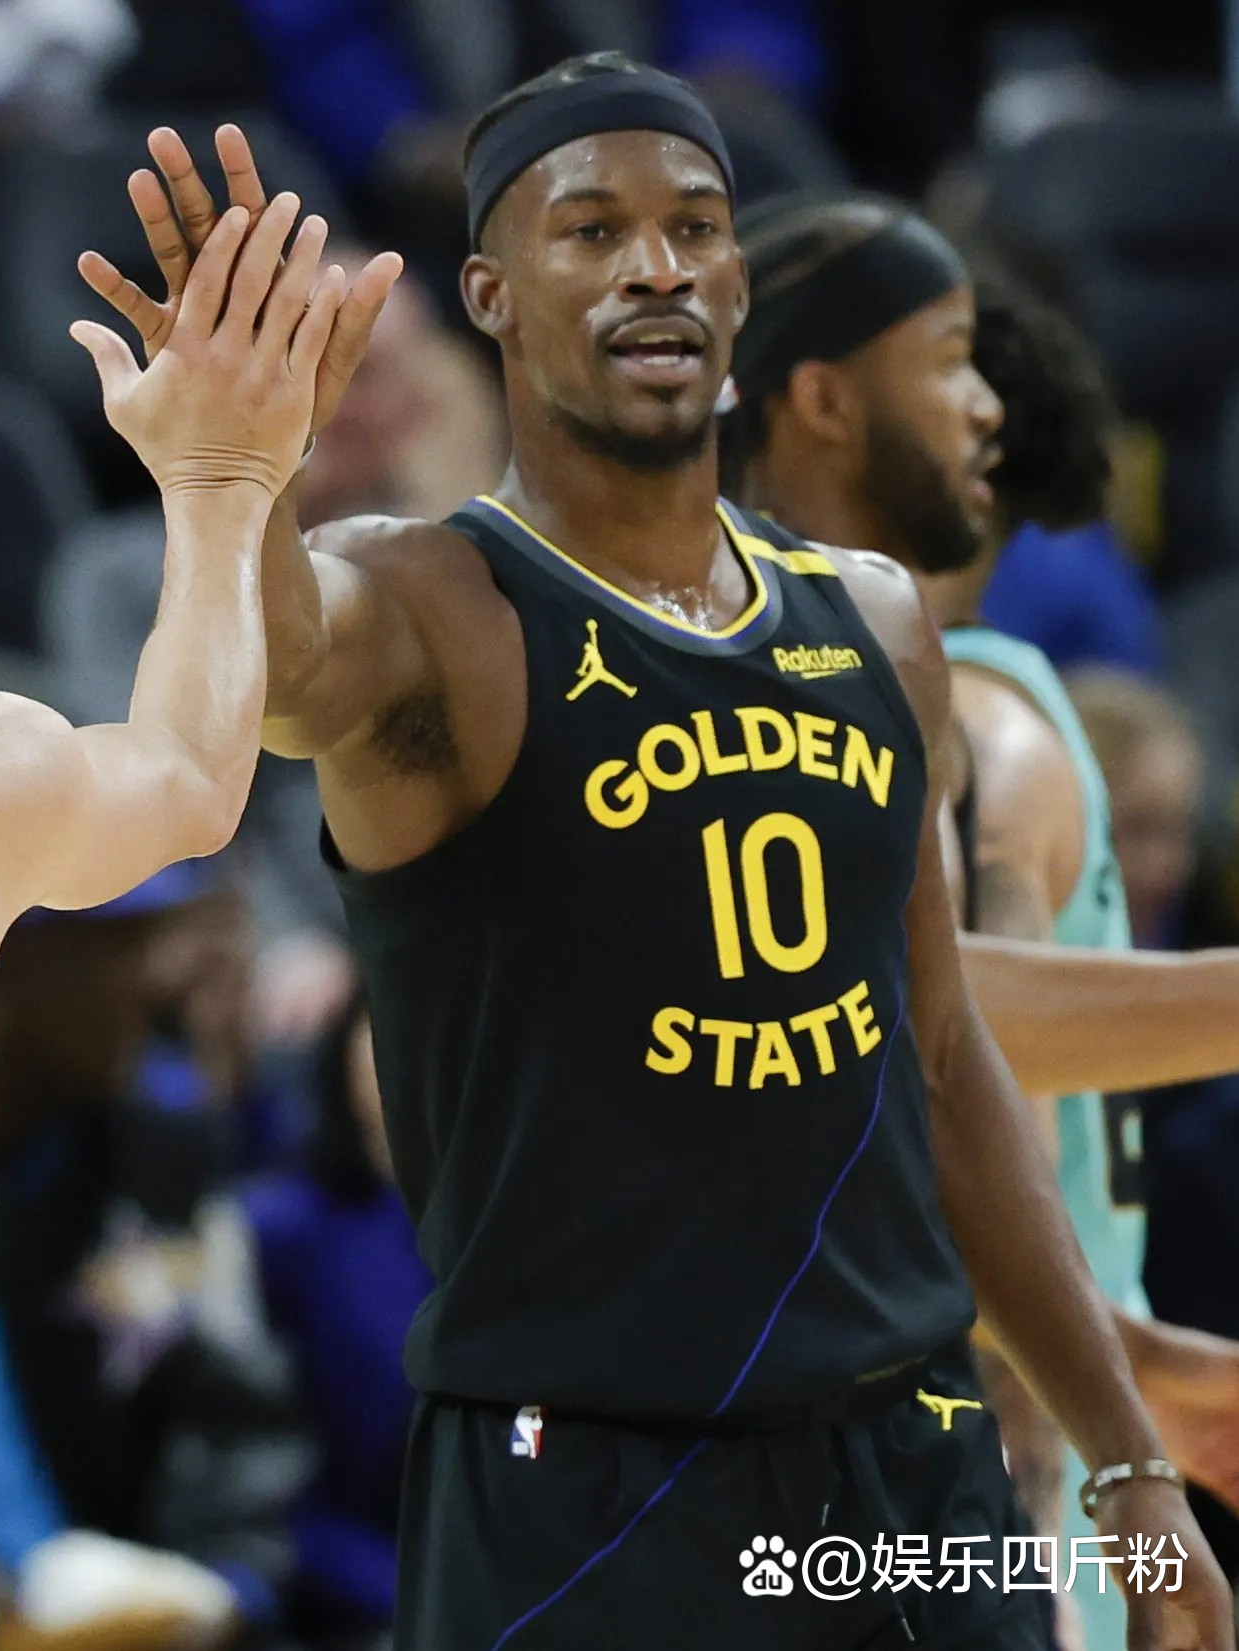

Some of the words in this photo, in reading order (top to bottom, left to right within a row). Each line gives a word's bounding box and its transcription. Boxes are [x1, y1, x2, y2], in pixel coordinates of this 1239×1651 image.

[772, 644, 863, 673] Rakuten
[585, 706, 895, 829] GOLDEN
[702, 812, 828, 979] 10
[645, 981, 882, 1090] STATE
